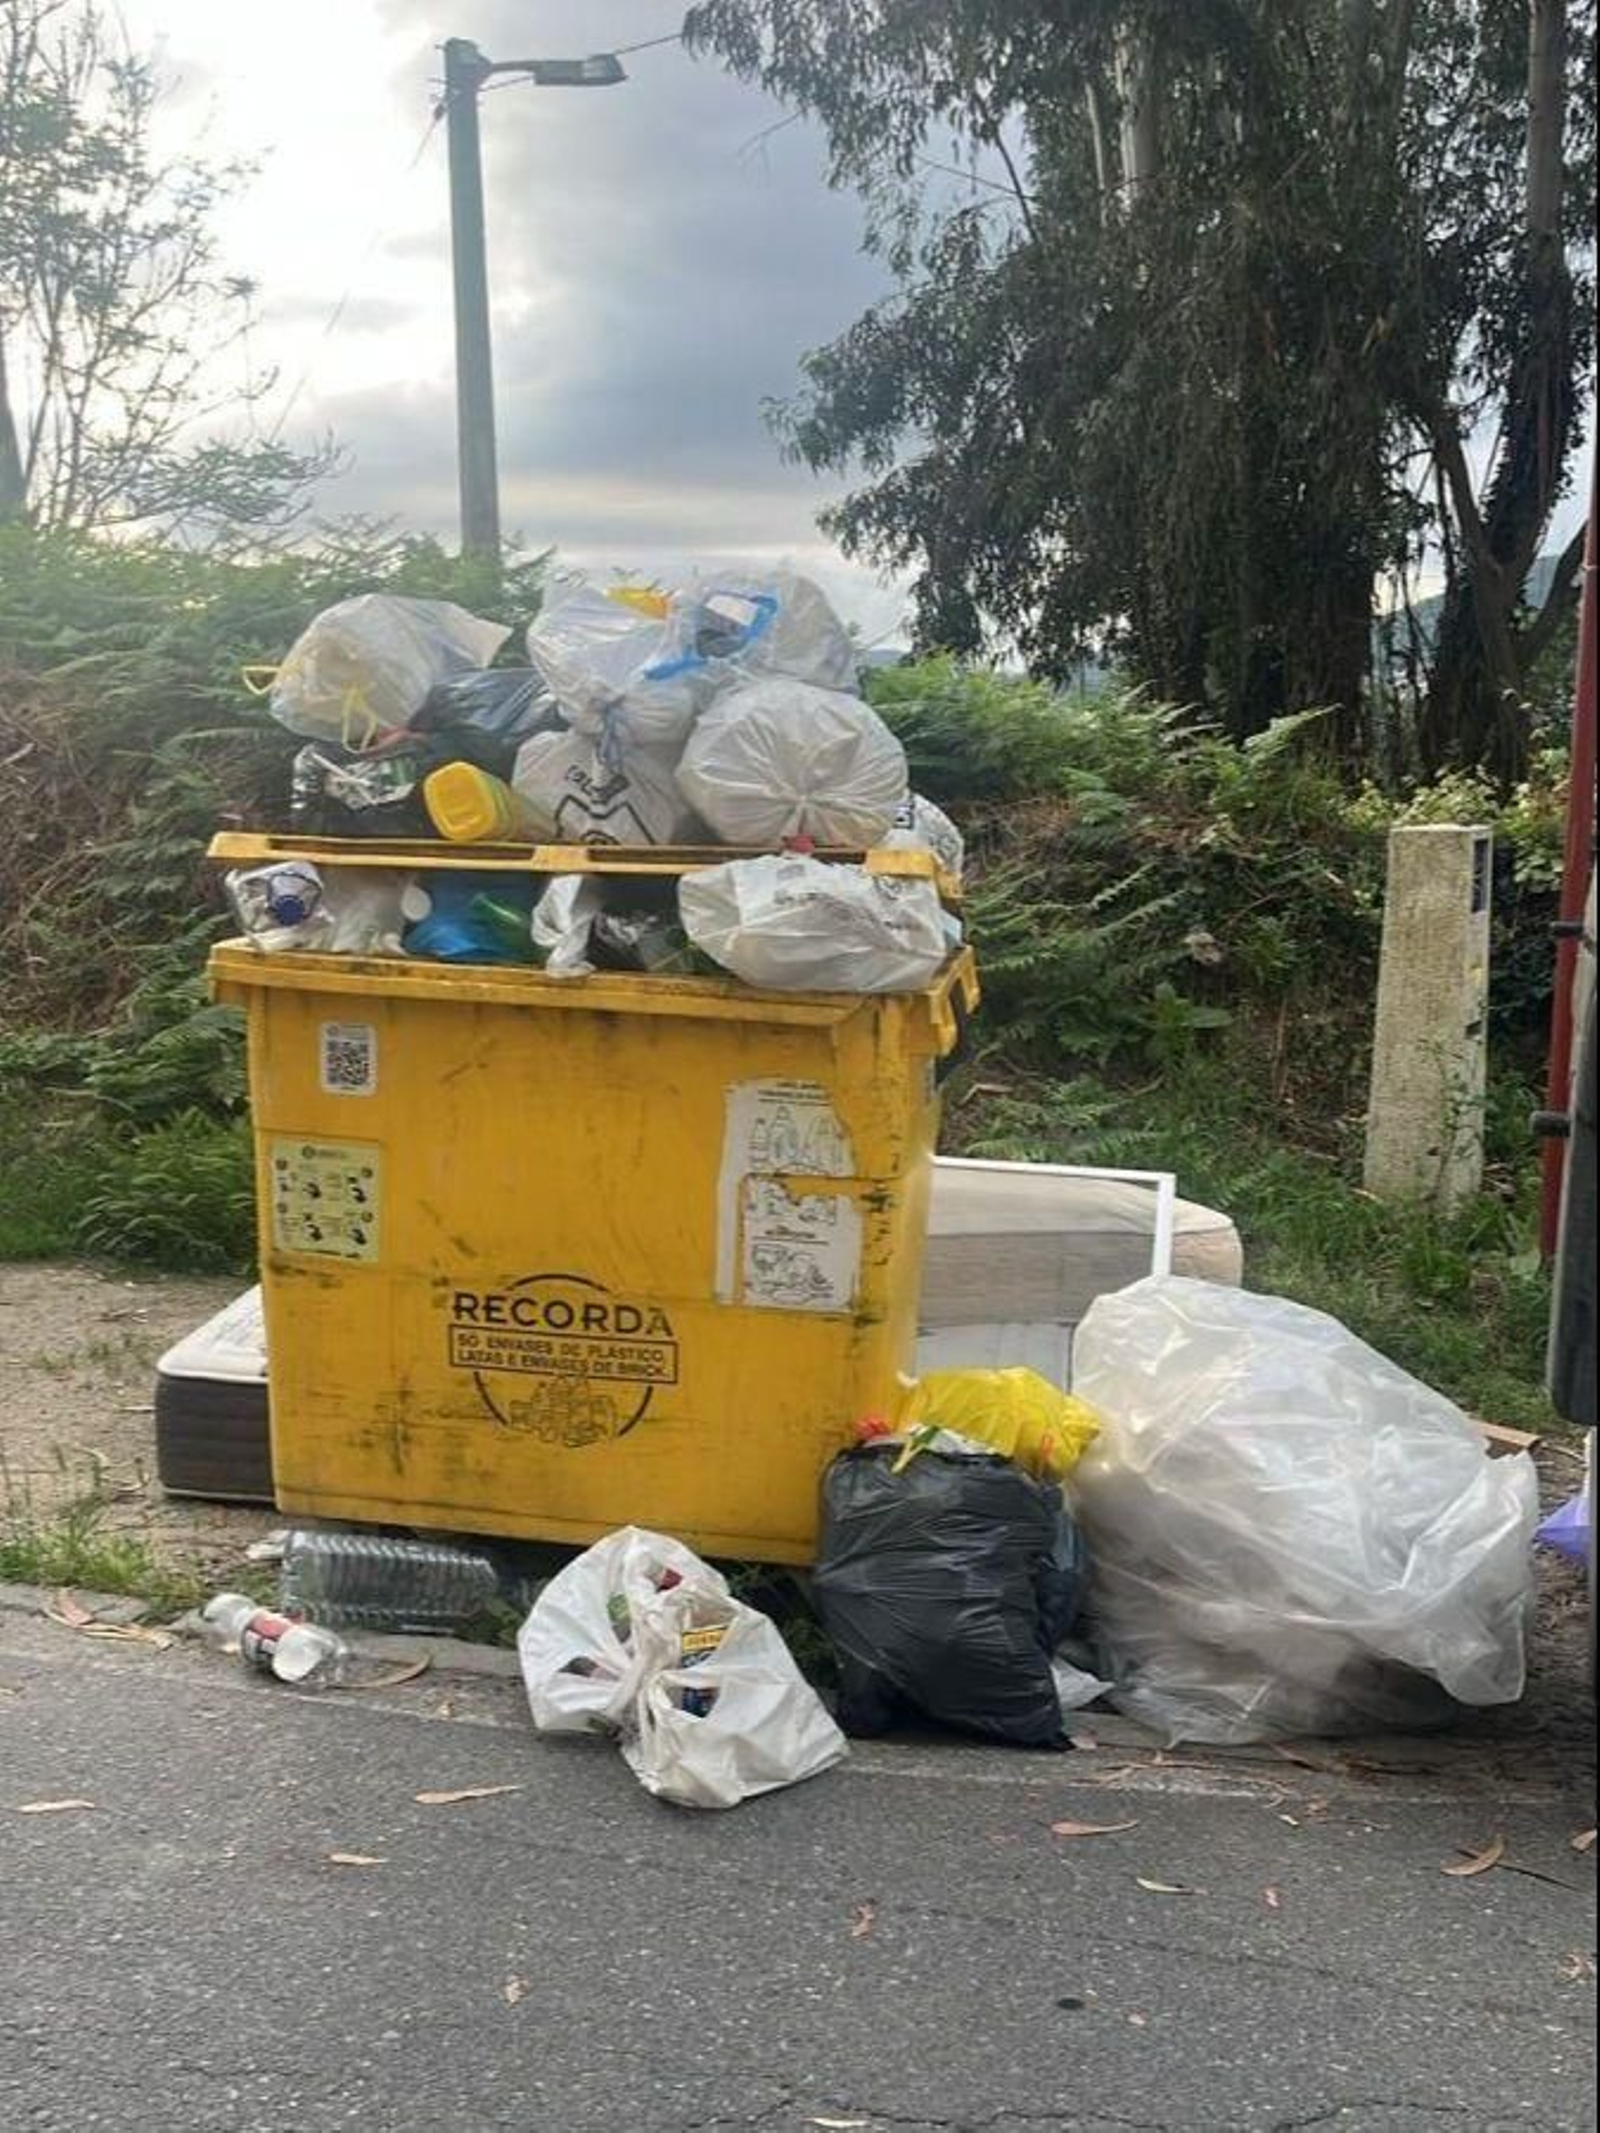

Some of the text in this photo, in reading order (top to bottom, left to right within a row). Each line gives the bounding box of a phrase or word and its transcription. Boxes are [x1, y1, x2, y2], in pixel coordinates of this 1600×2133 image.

[453, 1291, 673, 1337] RECORDA
[560, 1343, 581, 1357] DE
[508, 1353, 518, 1366] E
